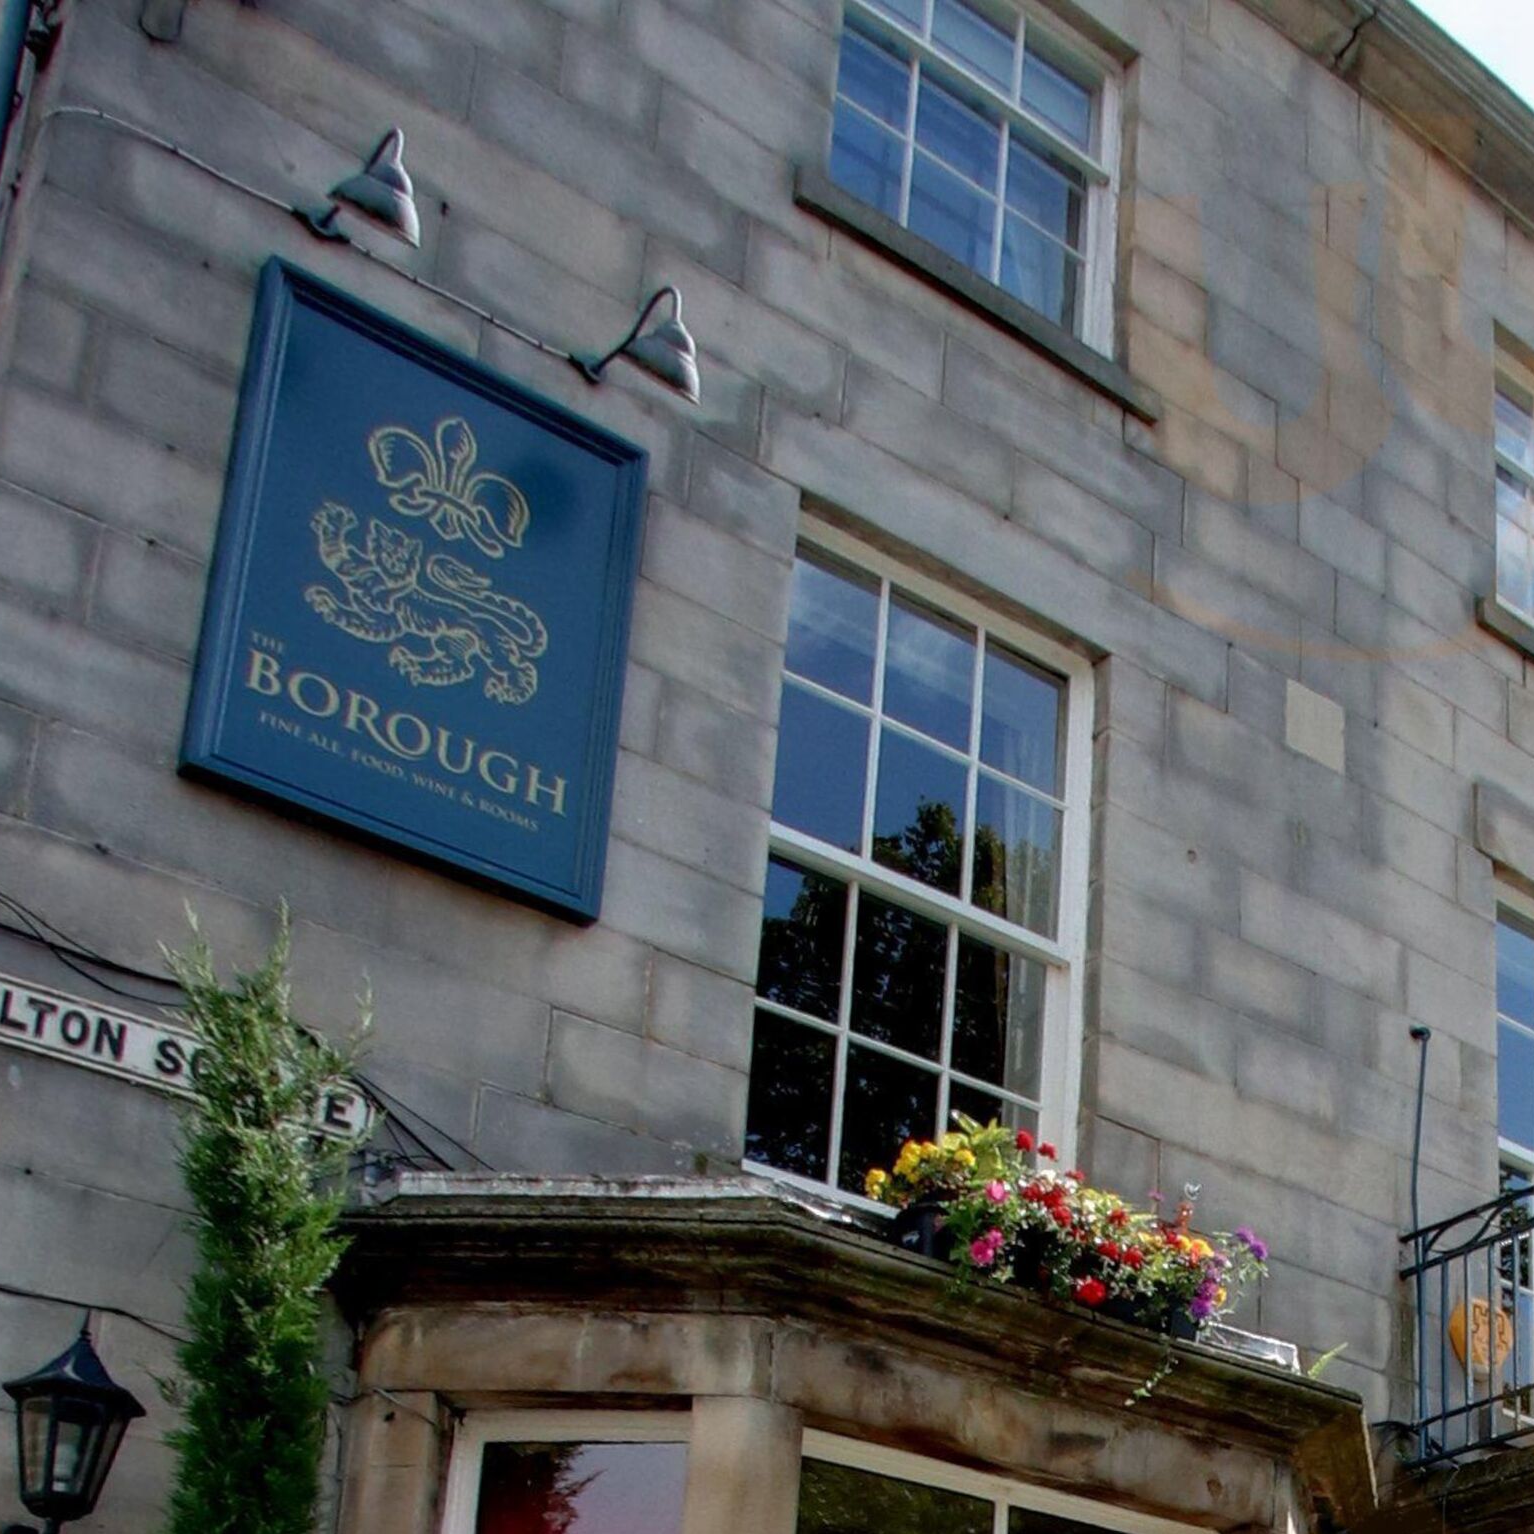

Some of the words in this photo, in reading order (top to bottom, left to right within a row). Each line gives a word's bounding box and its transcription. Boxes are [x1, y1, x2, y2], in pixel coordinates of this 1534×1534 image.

[250, 631, 285, 653] THE
[246, 650, 567, 818] BOROUGH
[259, 711, 301, 739] FINE
[479, 797, 538, 832] ROOMS
